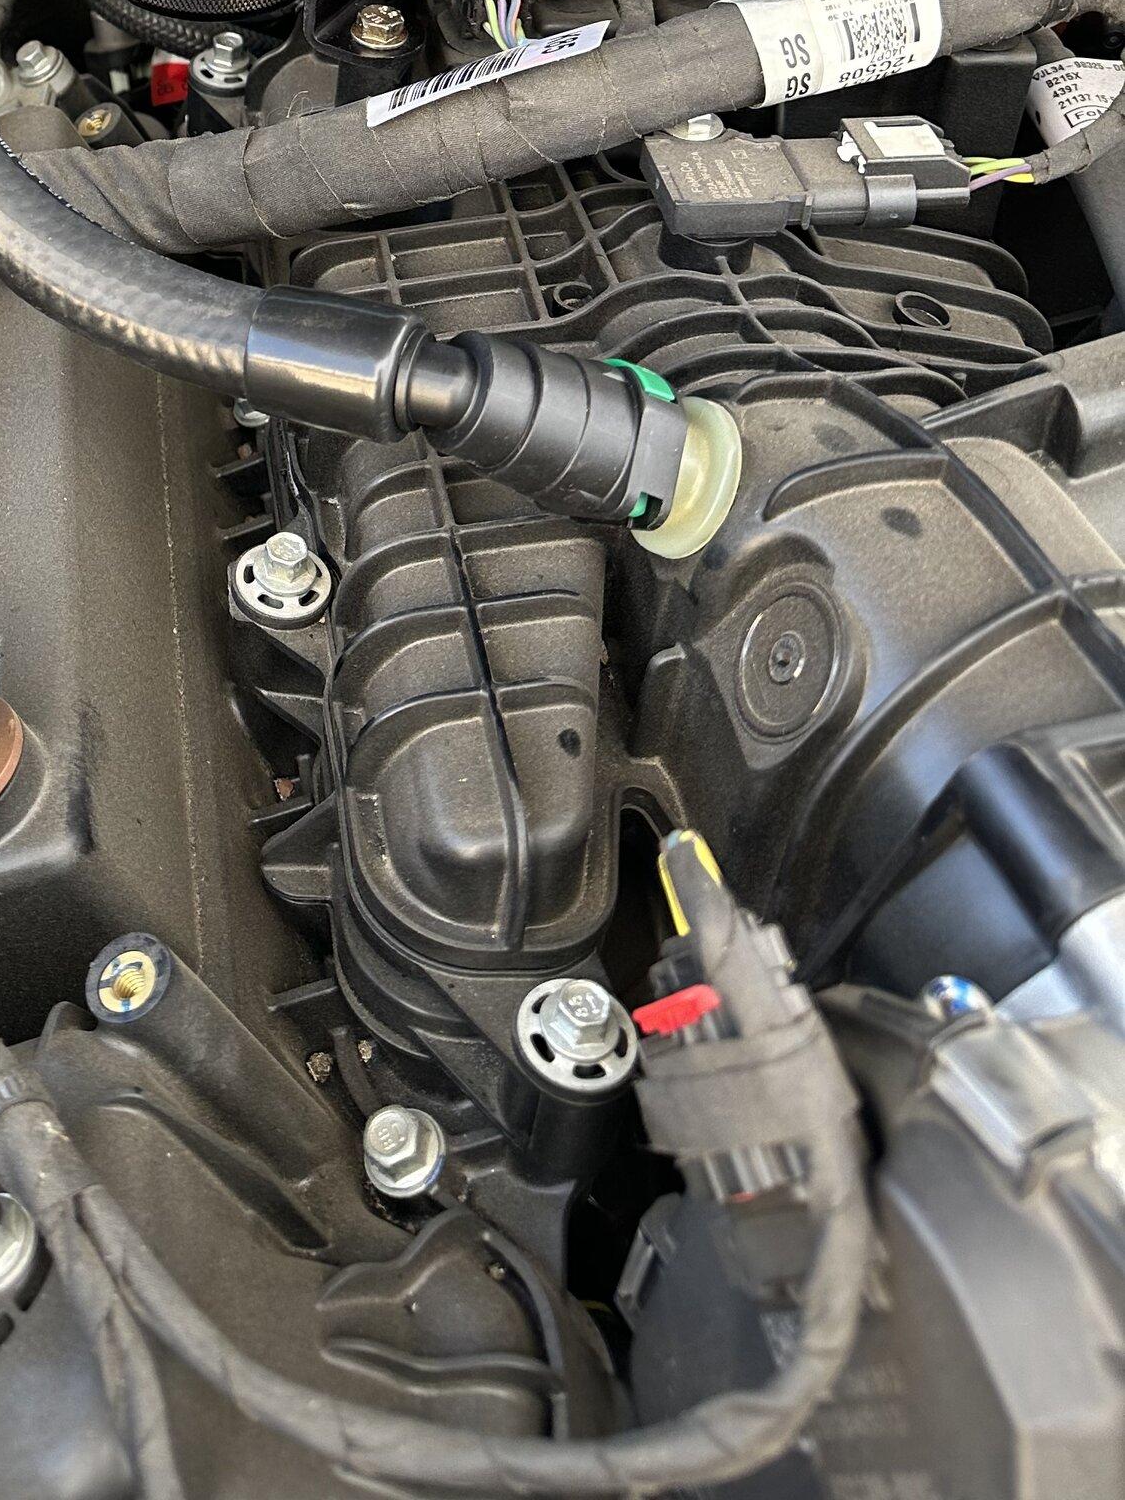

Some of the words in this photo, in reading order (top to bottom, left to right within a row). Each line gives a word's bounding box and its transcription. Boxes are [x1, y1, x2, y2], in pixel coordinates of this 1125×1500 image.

[779, 33, 811, 69] SG
[785, 73, 811, 99] SG
[1045, 72, 1082, 88] B215X
[1053, 84, 1079, 98] 4397
[1058, 93, 1092, 109] 21137
